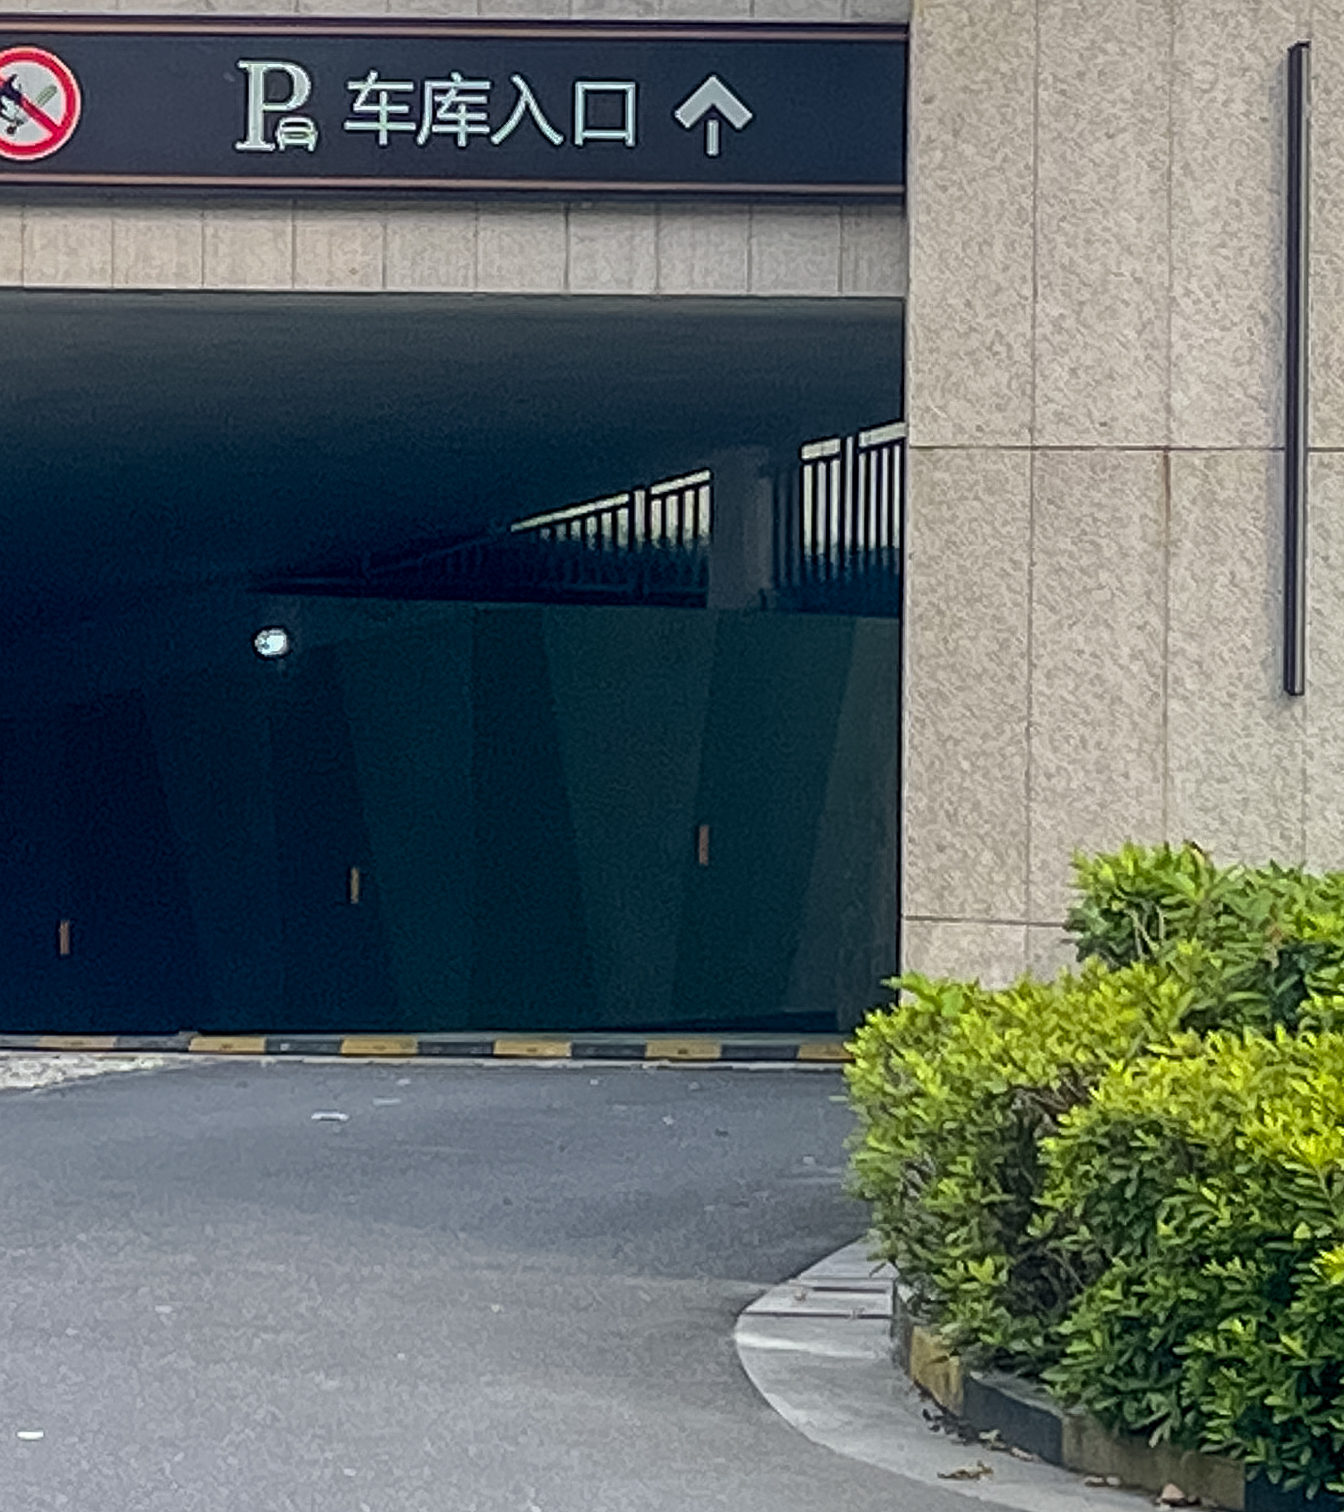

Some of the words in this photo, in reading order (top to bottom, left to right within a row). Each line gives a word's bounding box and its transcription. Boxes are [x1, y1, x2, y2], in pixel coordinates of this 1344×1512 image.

[235, 59, 312, 152] P
[343, 71, 637, 148] 车库入口
